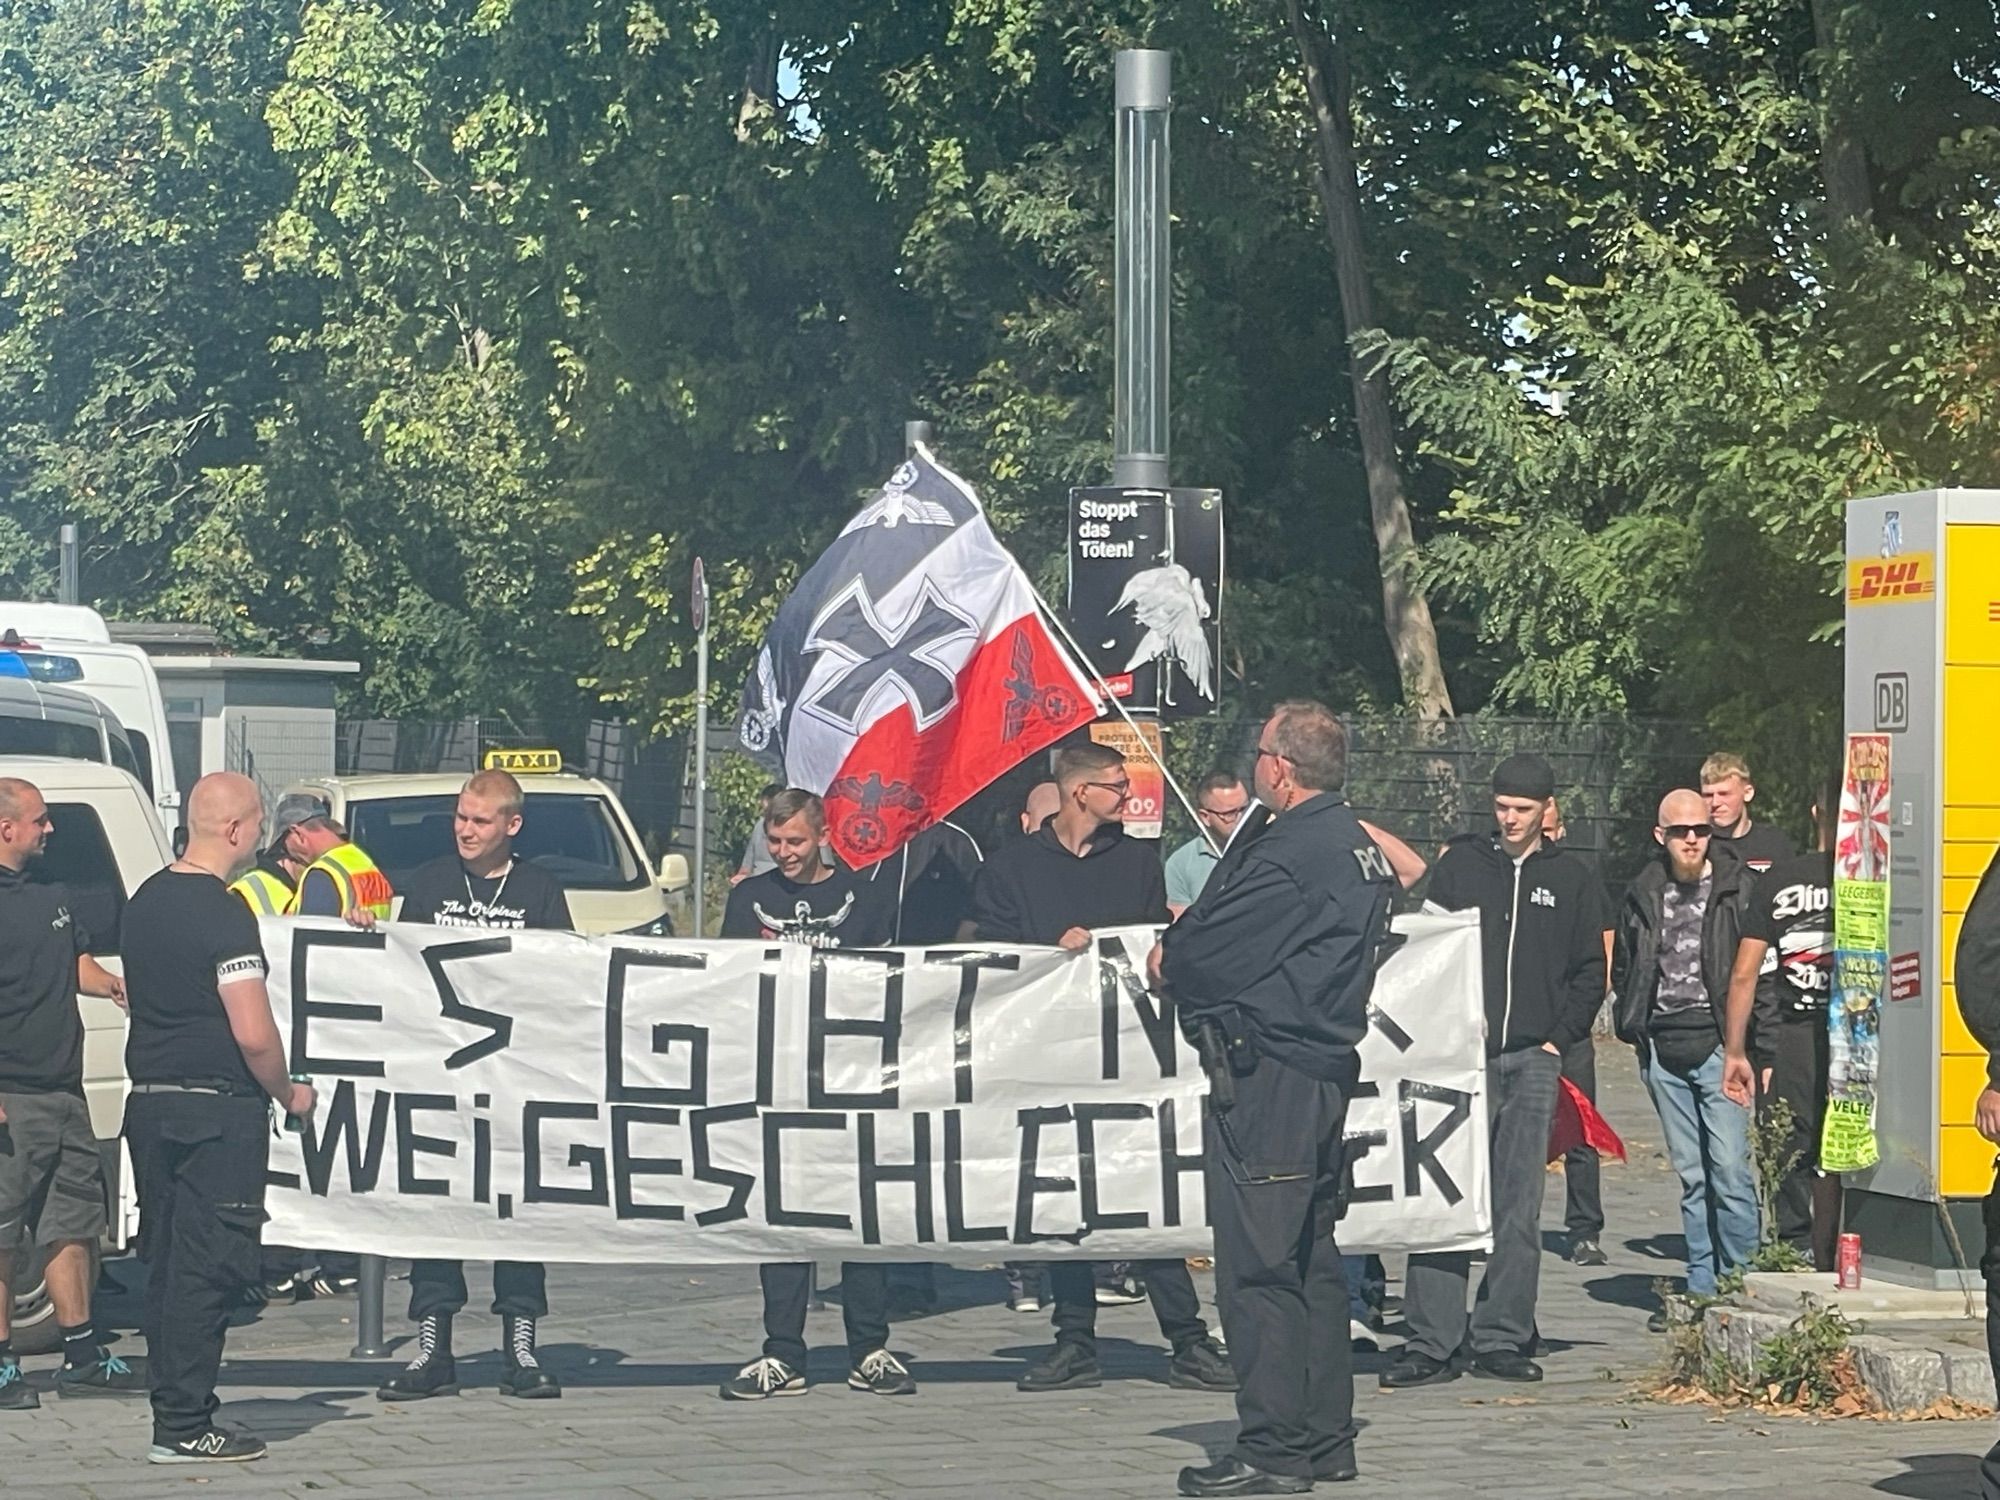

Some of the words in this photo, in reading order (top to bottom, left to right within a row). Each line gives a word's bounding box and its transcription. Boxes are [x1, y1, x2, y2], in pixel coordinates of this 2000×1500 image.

[1079, 500, 1138, 521] Stoppt
[1079, 521, 1111, 538] das
[1079, 540, 1134, 558] Töten!
[1861, 562, 1922, 598] DHL
[1879, 682, 1904, 723] DB
[500, 754, 550, 768] TAXI
[442, 900, 466, 914] The
[469, 901, 526, 919] Original
[291, 928, 513, 1077] ES
